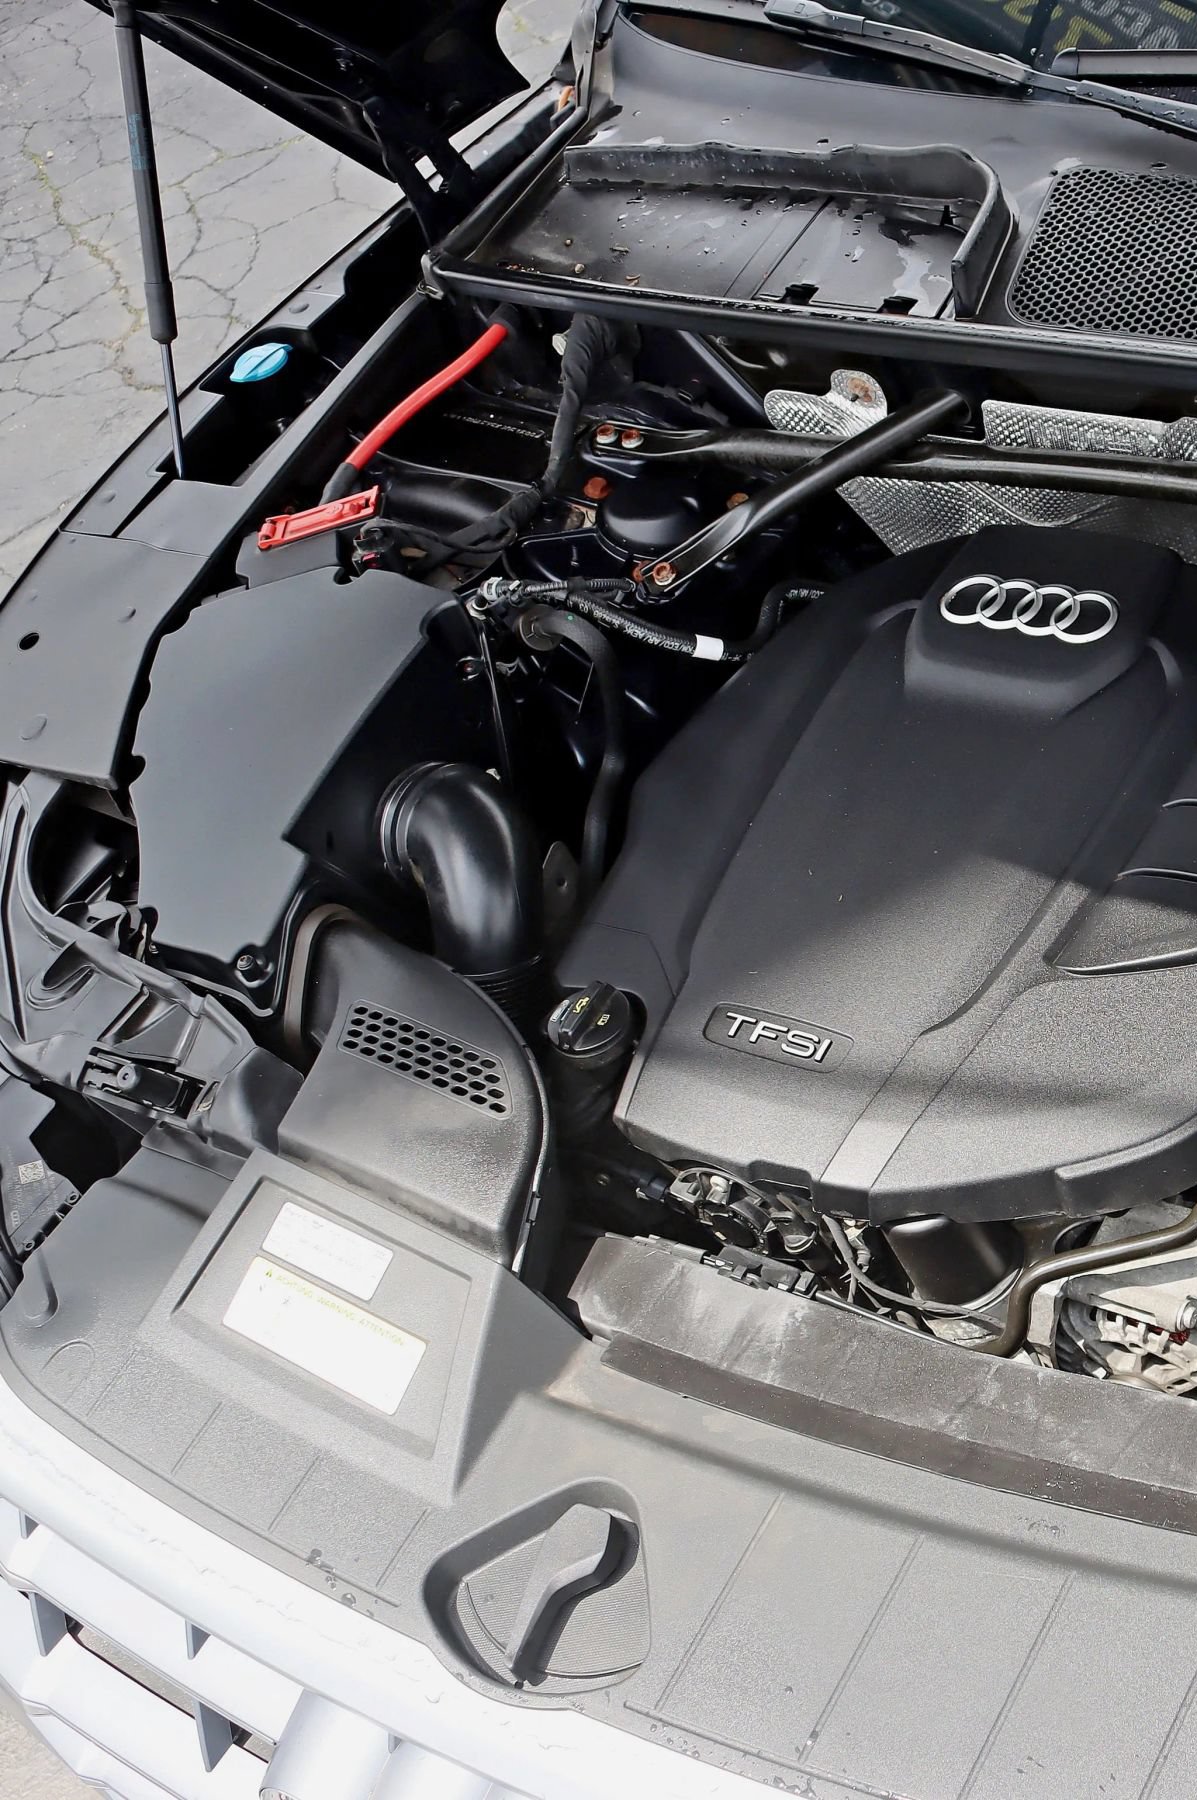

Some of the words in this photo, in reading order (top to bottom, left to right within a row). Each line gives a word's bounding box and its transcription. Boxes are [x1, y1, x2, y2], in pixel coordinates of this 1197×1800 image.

[726, 1011, 831, 1062] TFSI
[317, 1297, 355, 1320] WARNING
[359, 1319, 404, 1345] ATTENTION
